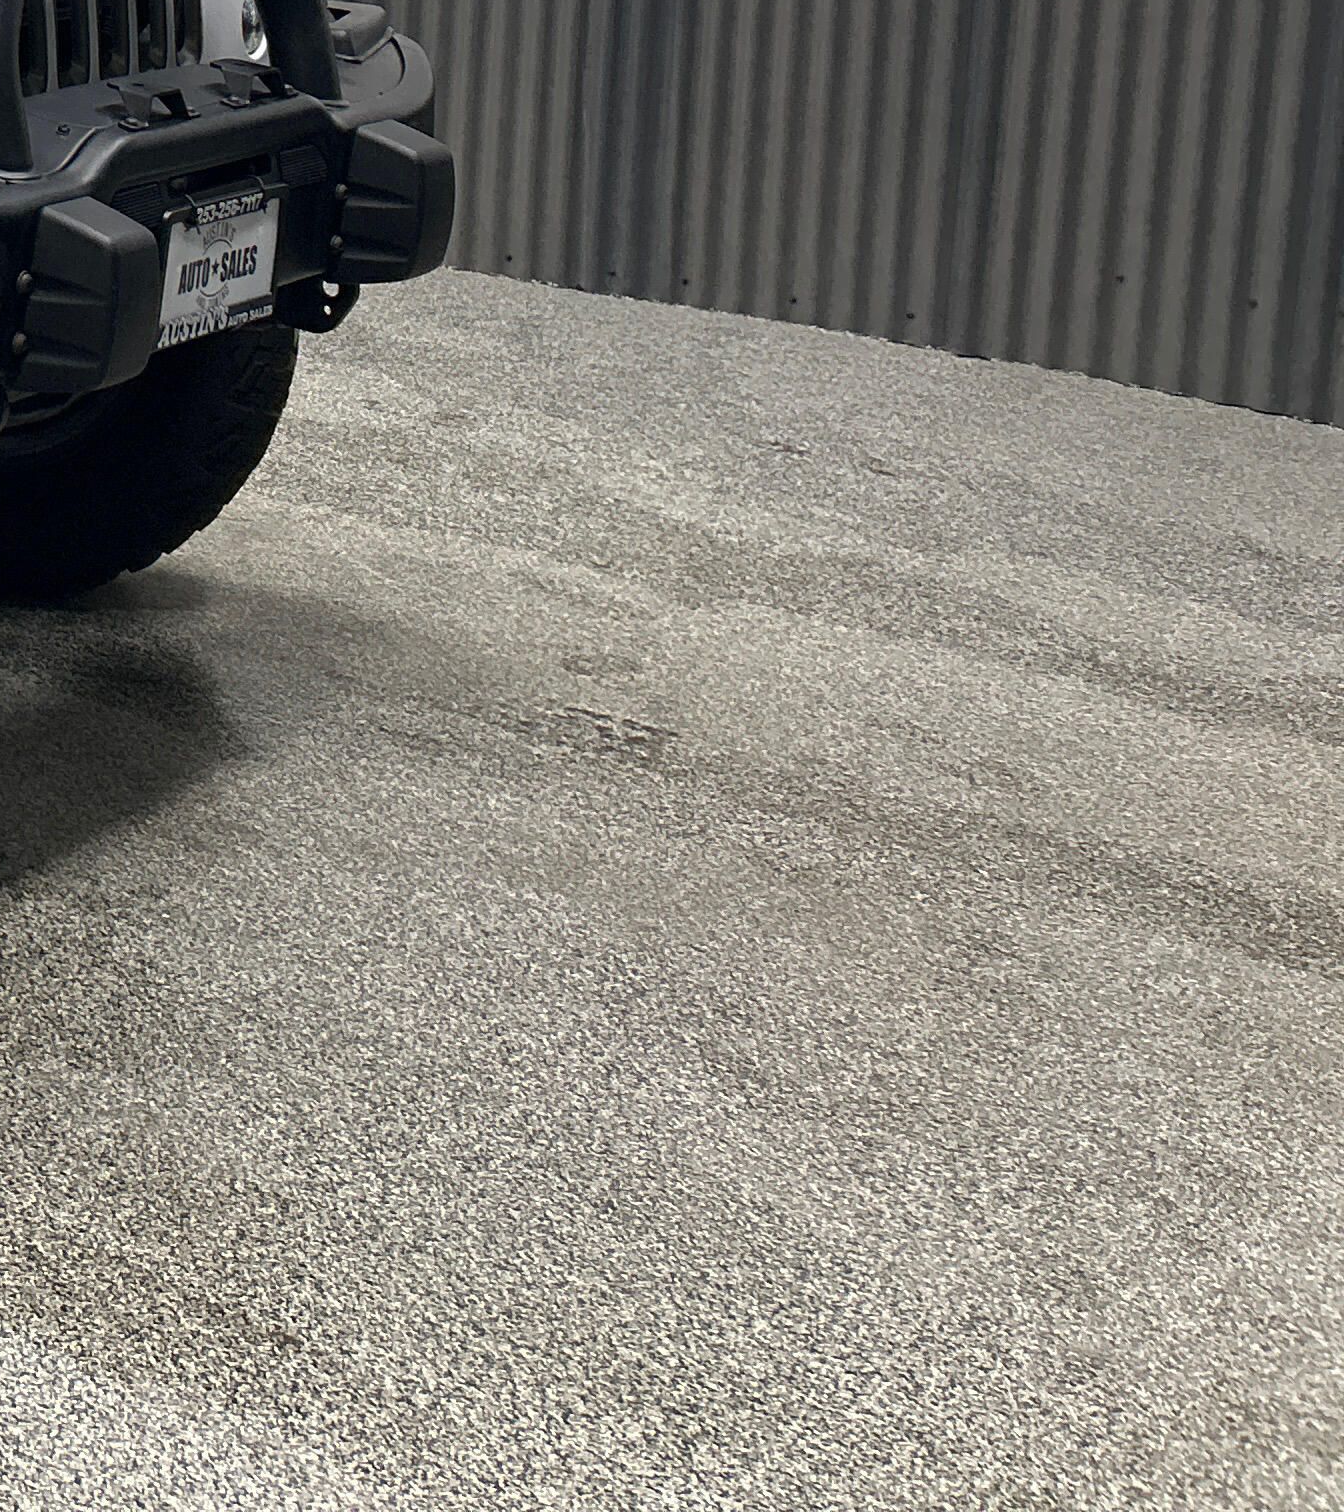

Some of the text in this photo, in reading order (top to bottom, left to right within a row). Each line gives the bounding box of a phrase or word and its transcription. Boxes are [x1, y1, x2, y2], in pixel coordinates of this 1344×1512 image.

[178, 244, 258, 295] AUTO SALES
[157, 305, 230, 349] AUSTIN'S
